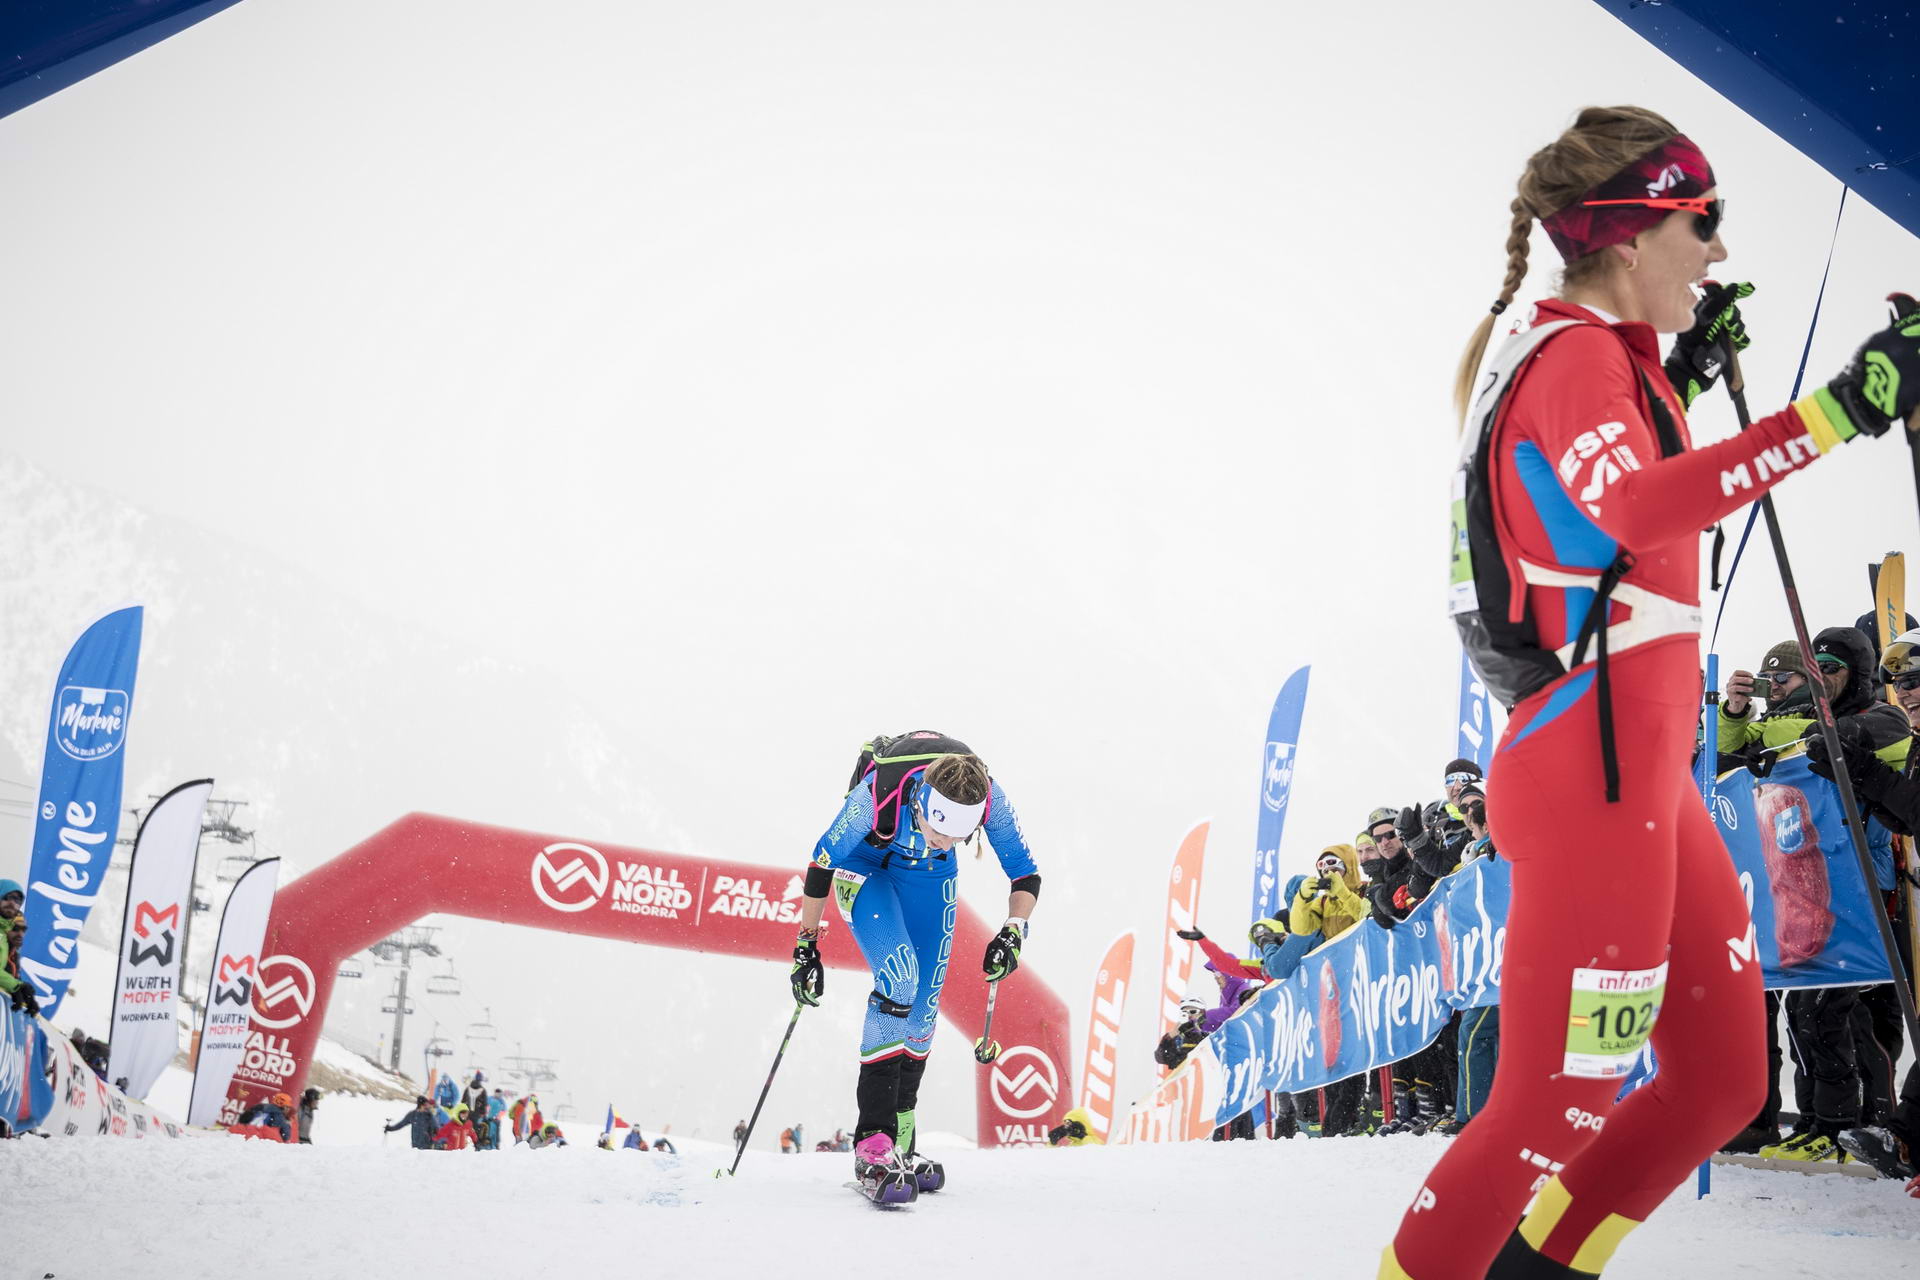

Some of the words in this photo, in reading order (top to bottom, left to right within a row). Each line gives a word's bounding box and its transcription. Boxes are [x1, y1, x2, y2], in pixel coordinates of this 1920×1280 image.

[1558, 420, 1627, 489] ESP
[60, 702, 121, 740] Marlene
[617, 861, 686, 889] VALL
[712, 875, 767, 900] PAL
[612, 879, 693, 911] NORD
[611, 901, 679, 920] ANDORRA
[123, 991, 171, 1004] MODYF
[1591, 1001, 1654, 1038] 102
[242, 1048, 297, 1077] ORD
[995, 1124, 1051, 1143] VALL
